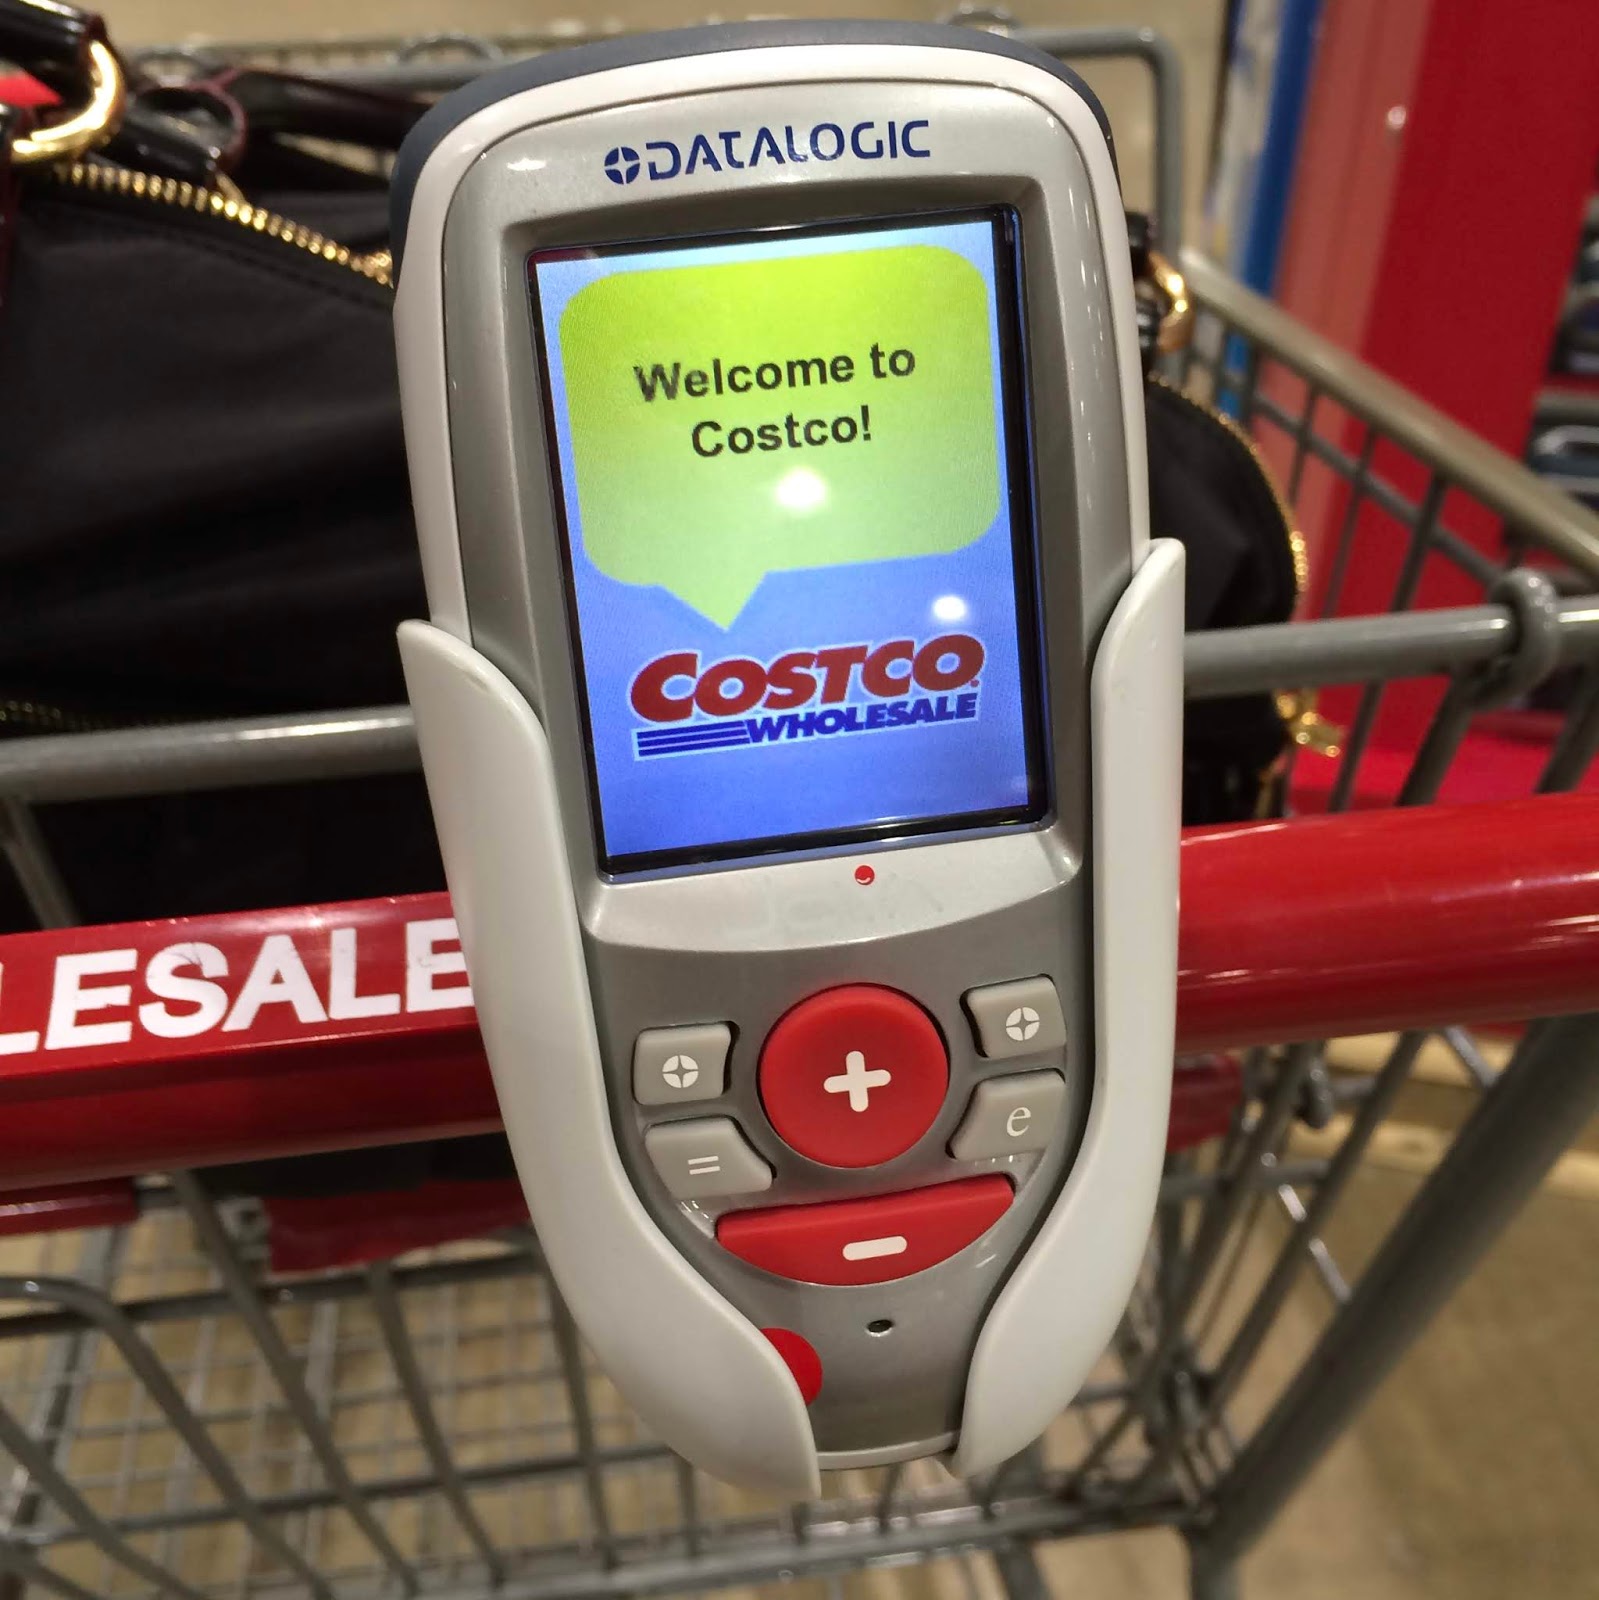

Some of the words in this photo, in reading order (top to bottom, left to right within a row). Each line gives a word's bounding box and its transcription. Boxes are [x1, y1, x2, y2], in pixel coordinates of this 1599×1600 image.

[645, 120, 931, 181] DATALOGIC
[633, 354, 855, 402] Welcome
[869, 343, 916, 378] to
[691, 405, 873, 457] Costco!
[630, 633, 985, 722] COSTCO
[747, 693, 979, 744] WHOLESALE
